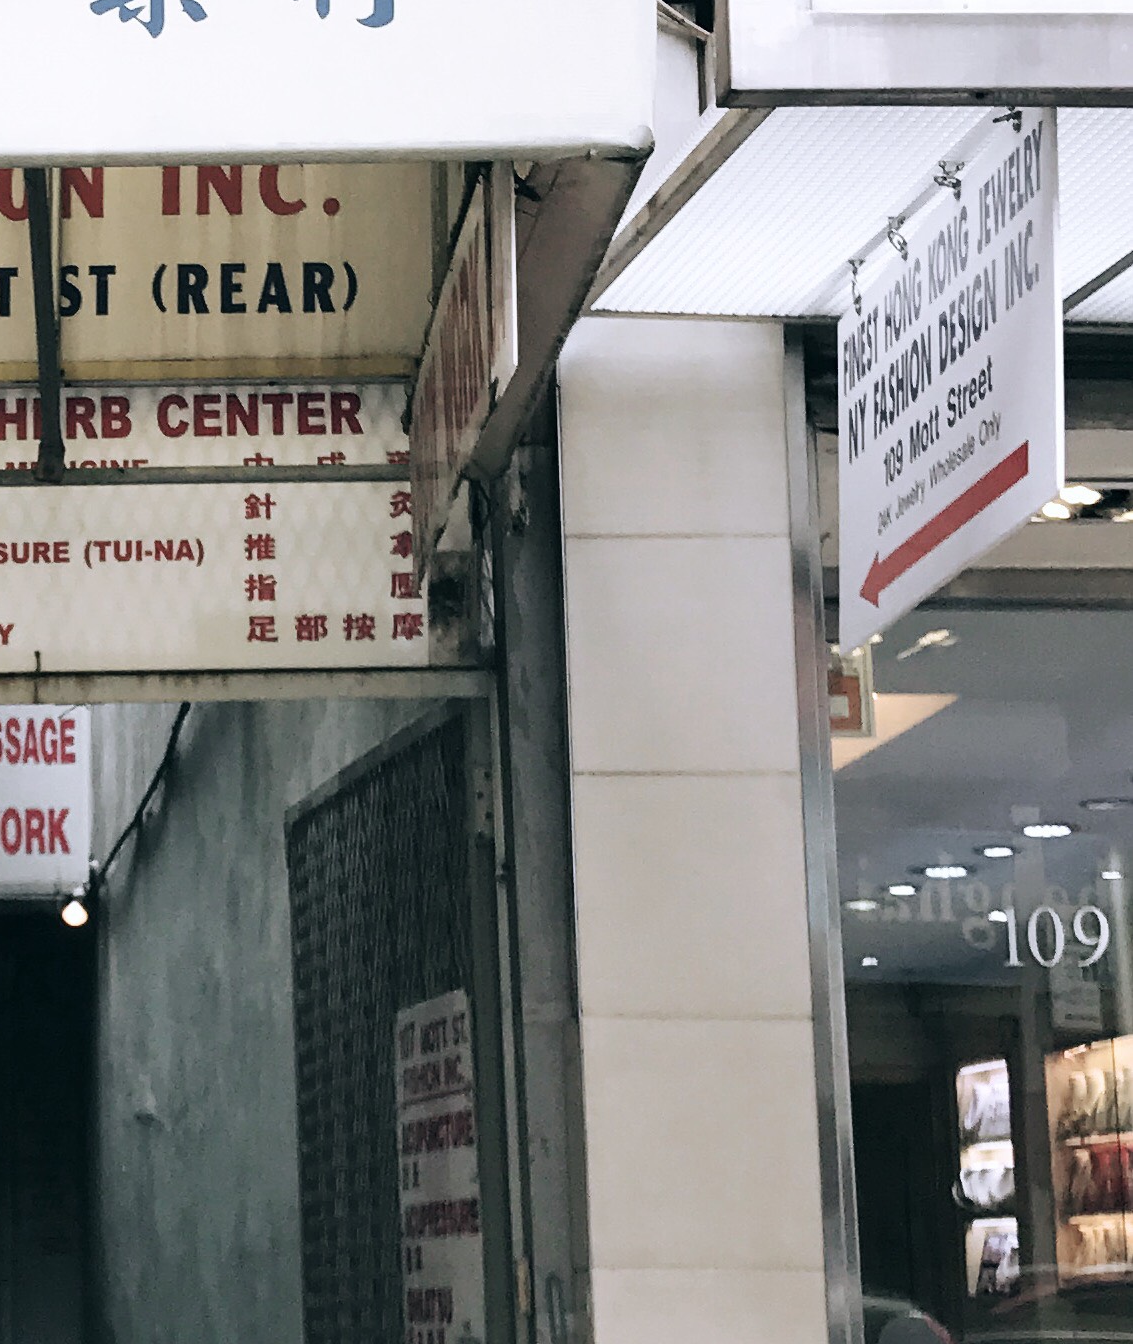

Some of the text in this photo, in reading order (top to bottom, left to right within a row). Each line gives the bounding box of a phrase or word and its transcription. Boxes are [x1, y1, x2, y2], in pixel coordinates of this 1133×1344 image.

[161, 164, 341, 217] INC.
[842, 120, 1043, 397] FINEST HONG KONG JEWELRY
[59, 264, 117, 318] ST
[152, 261, 359, 315] (REAR)
[848, 218, 1041, 464] NY FASHION DESIGN INC.
[156, 392, 365, 439] CENTER
[883, 354, 994, 487] 109 Mott Street
[83, 537, 206, 570] (TUI-NA)
[1004, 905, 1110, 969] 109
